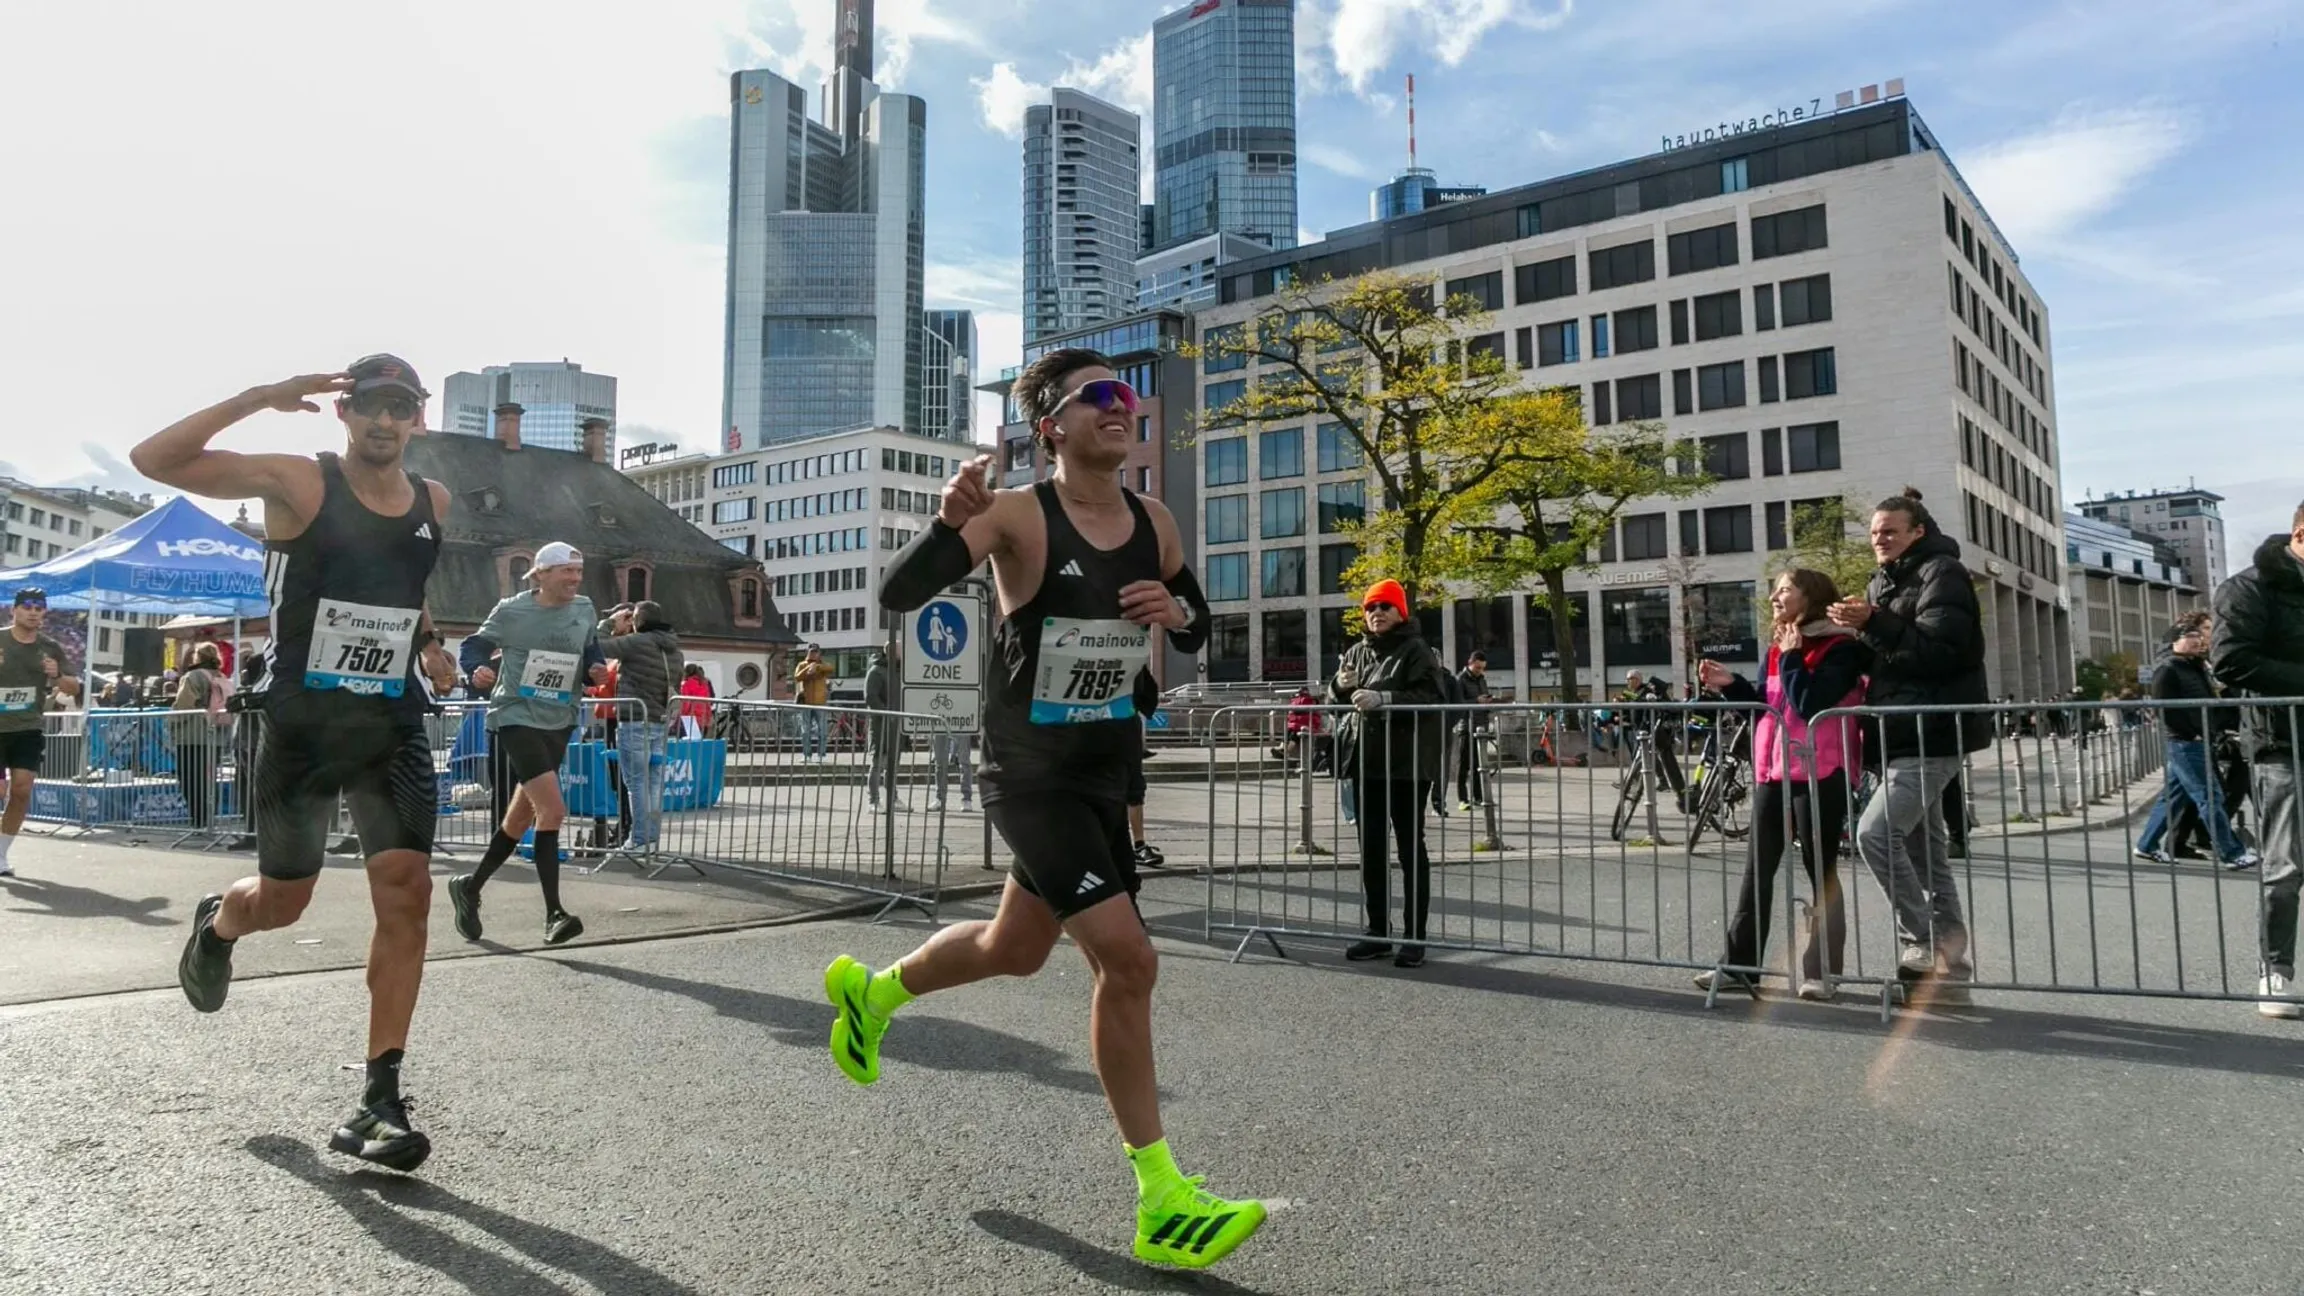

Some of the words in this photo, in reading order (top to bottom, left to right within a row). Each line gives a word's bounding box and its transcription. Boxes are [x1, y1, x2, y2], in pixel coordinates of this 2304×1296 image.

[1661, 106, 1804, 152] hauptwache
[1809, 98, 1821, 116] 7
[156, 538, 263, 562] HOKA
[130, 566, 179, 591] FLY
[1597, 570, 1668, 586] WEMPE
[1080, 633, 1145, 648] mainova
[1702, 644, 1742, 653] WEMPE
[335, 644, 394, 674] 7502
[923, 664, 962, 680] ZONE
[1063, 670, 1126, 700] 7895
